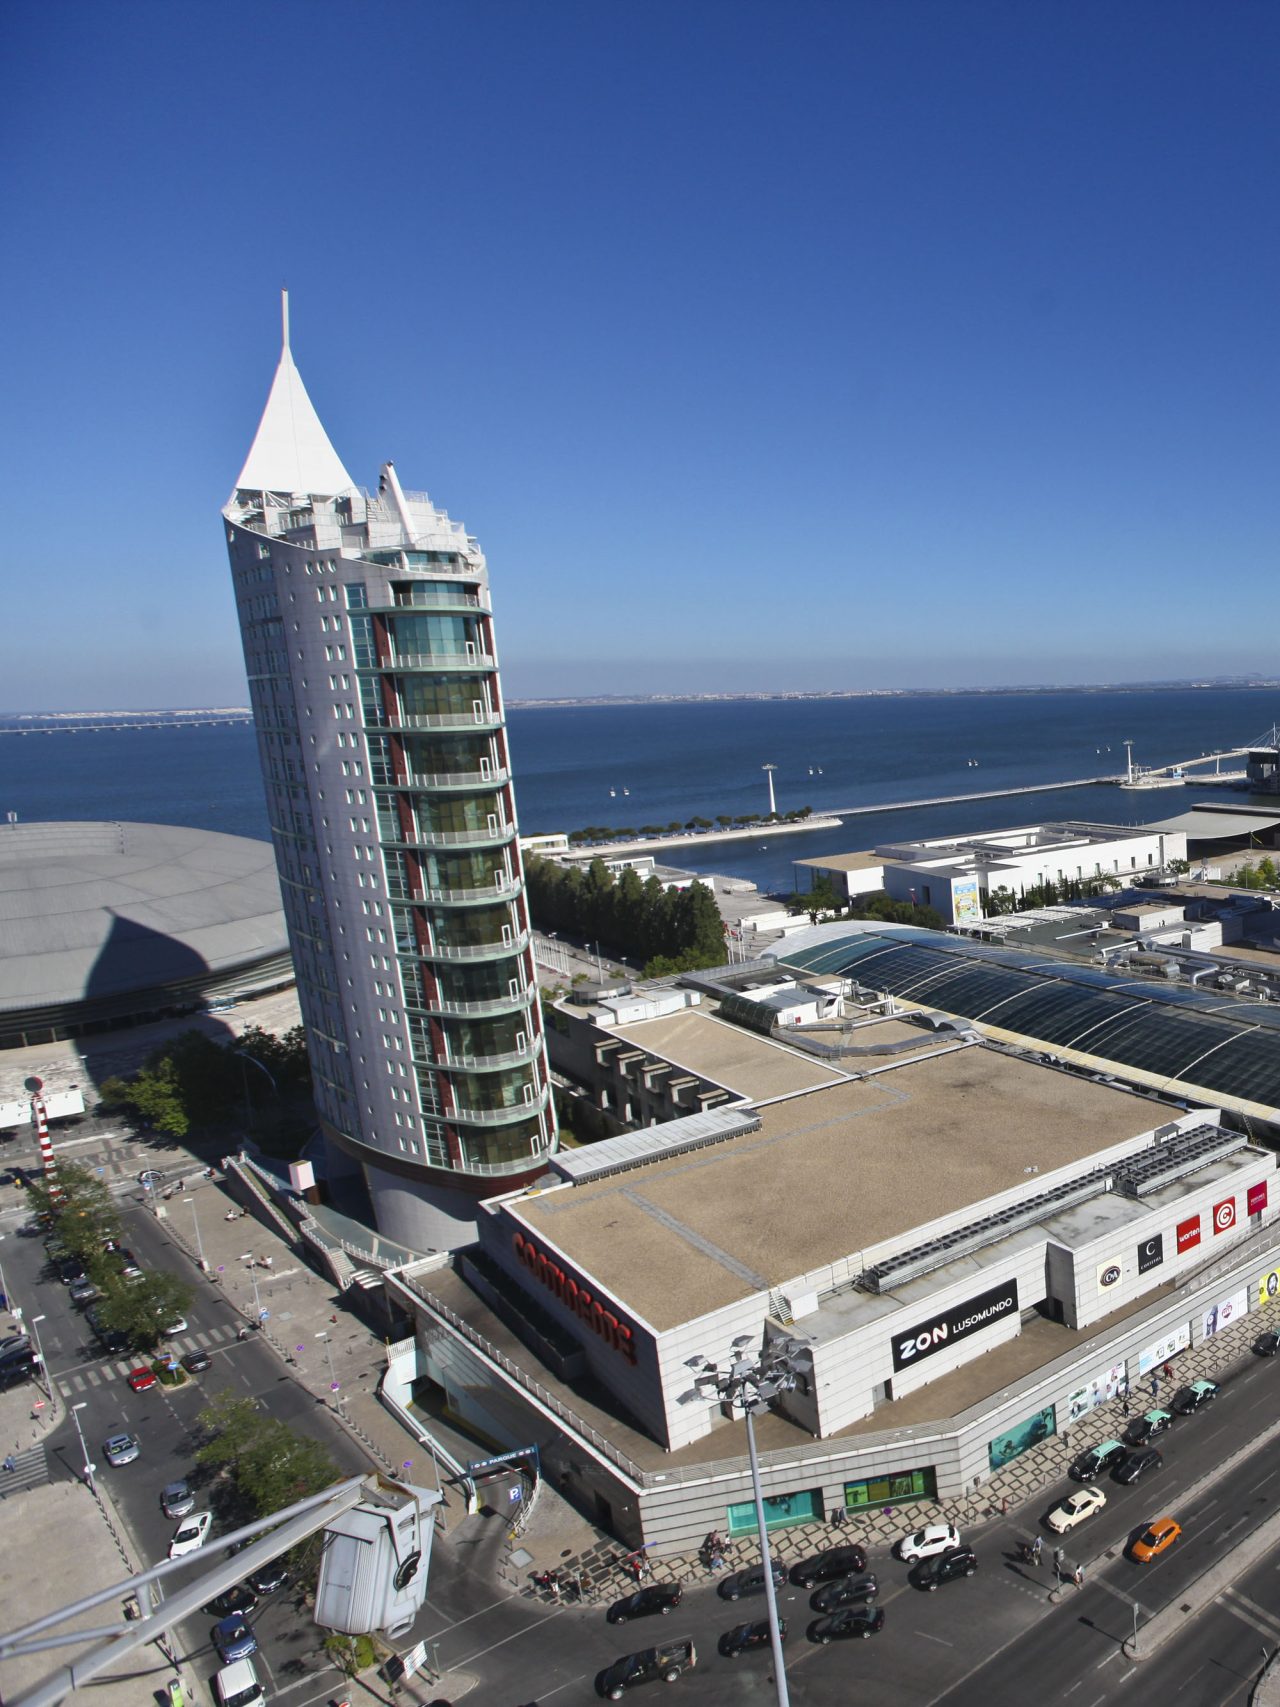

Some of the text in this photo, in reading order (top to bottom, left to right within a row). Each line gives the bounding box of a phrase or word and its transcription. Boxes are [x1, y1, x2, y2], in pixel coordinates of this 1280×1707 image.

[1179, 1227, 1200, 1242] worten
[1146, 1241, 1156, 1256] C
[900, 1297, 1013, 1360] ZON LUSOMUNDO
[489, 1453, 517, 1465] PARQUE
[510, 1488, 519, 1500] P
